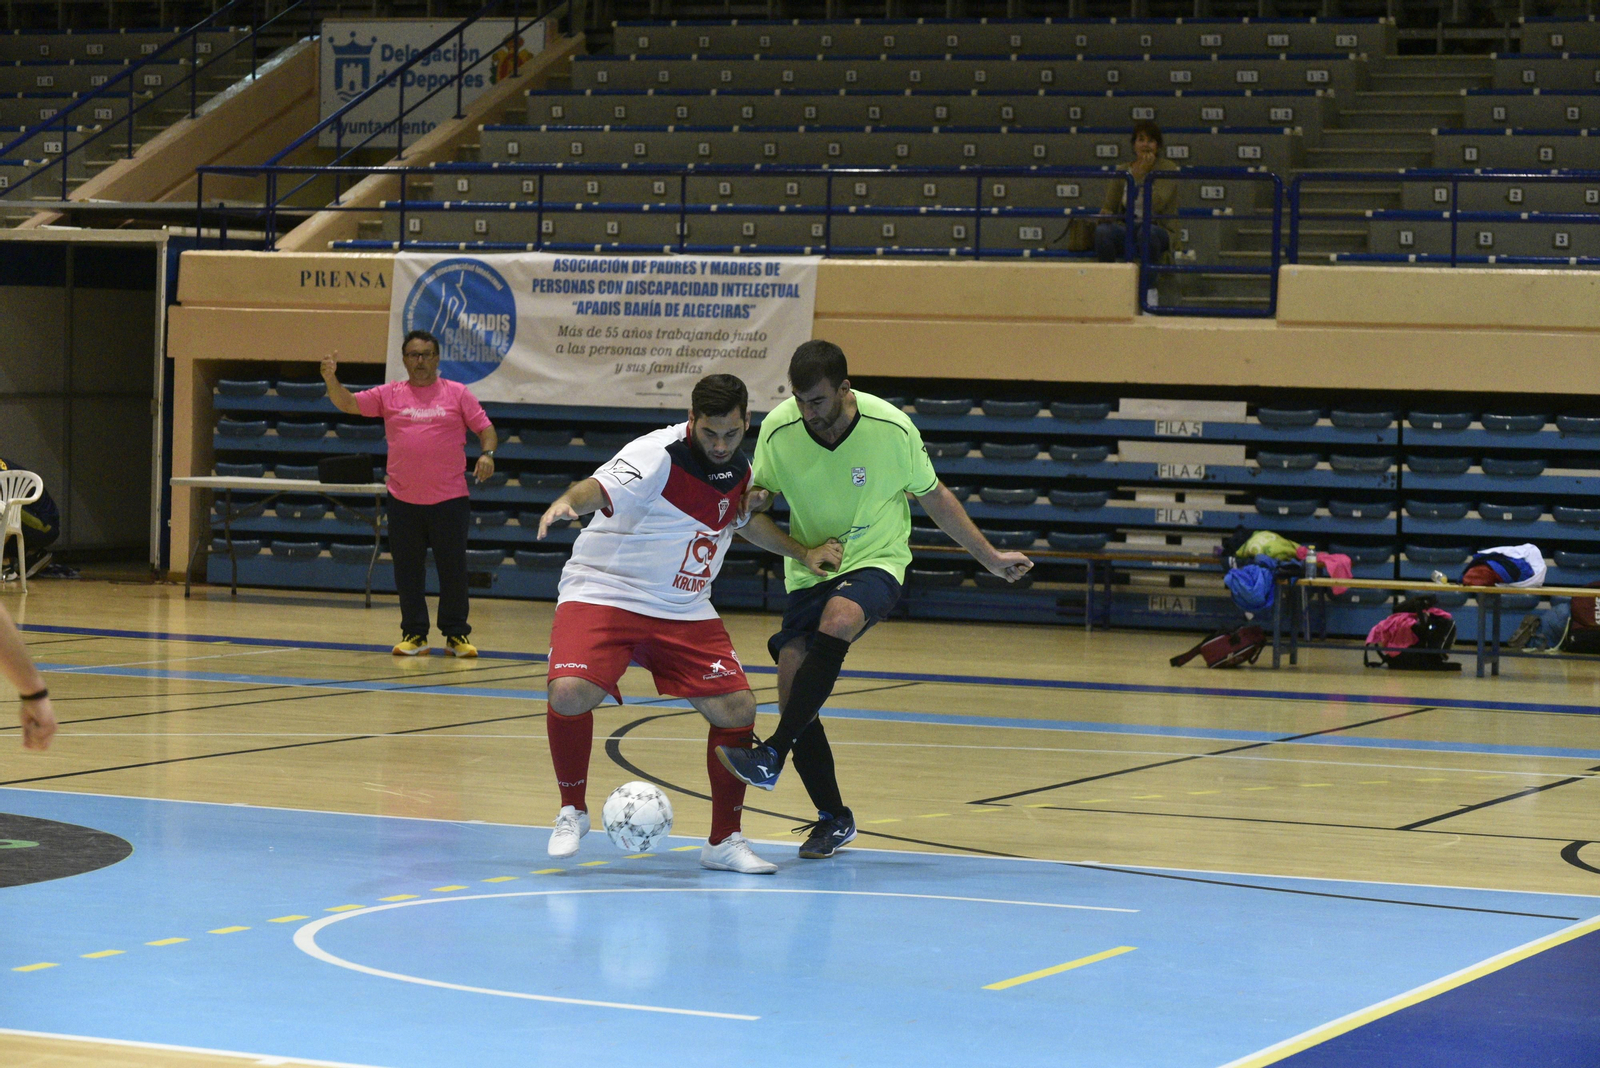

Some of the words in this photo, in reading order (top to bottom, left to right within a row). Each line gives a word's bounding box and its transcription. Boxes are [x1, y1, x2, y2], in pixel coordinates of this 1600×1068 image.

[1569, 108, 1577, 118] 2
[46, 143, 59, 151] 12
[1542, 149, 1551, 159] 2
[1511, 190, 1520, 200] 2
[1588, 191, 1596, 201] 3
[1481, 233, 1490, 244] 2
[1557, 234, 1566, 244] 3
[552, 258, 629, 274] ASOCIACIÓN
[631, 260, 648, 275] DE
[649, 260, 697, 275] PADRES
[700, 262, 709, 275] Y
[710, 262, 763, 277] MADRES
[765, 262, 781, 277] DE
[300, 270, 386, 288] PRENSA
[532, 278, 596, 294] PERSONAS
[598, 280, 624, 295] CON
[625, 280, 719, 297] DISCAPACIDAD
[721, 282, 800, 298] INTELECTUAL
[624, 300, 662, 317] BAHÍA
[664, 303, 681, 317] DE
[458, 313, 510, 332] APADIS
[491, 330, 510, 347] DE
[557, 325, 583, 338] Más
[586, 326, 603, 338] de
[604, 327, 620, 339] 55
[622, 328, 653, 340] años
[655, 328, 731, 343] trabajando
[731, 330, 767, 343] junto
[556, 344, 565, 354] a
[567, 342, 586, 355] las
[588, 344, 648, 358] personas
[650, 346, 673, 357] con
[675, 345, 768, 360] discapacidad
[615, 362, 624, 375] y
[626, 362, 646, 374] sus
[647, 361, 704, 375] familias
[1157, 421, 1188, 434] FILA
[1192, 421, 1201, 435] 5
[1159, 464, 1191, 477] FILA
[1194, 465, 1203, 477] 4
[1156, 509, 1188, 522] FILA
[1150, 597, 1182, 610] FILA
[1189, 598, 1195, 610] 1
